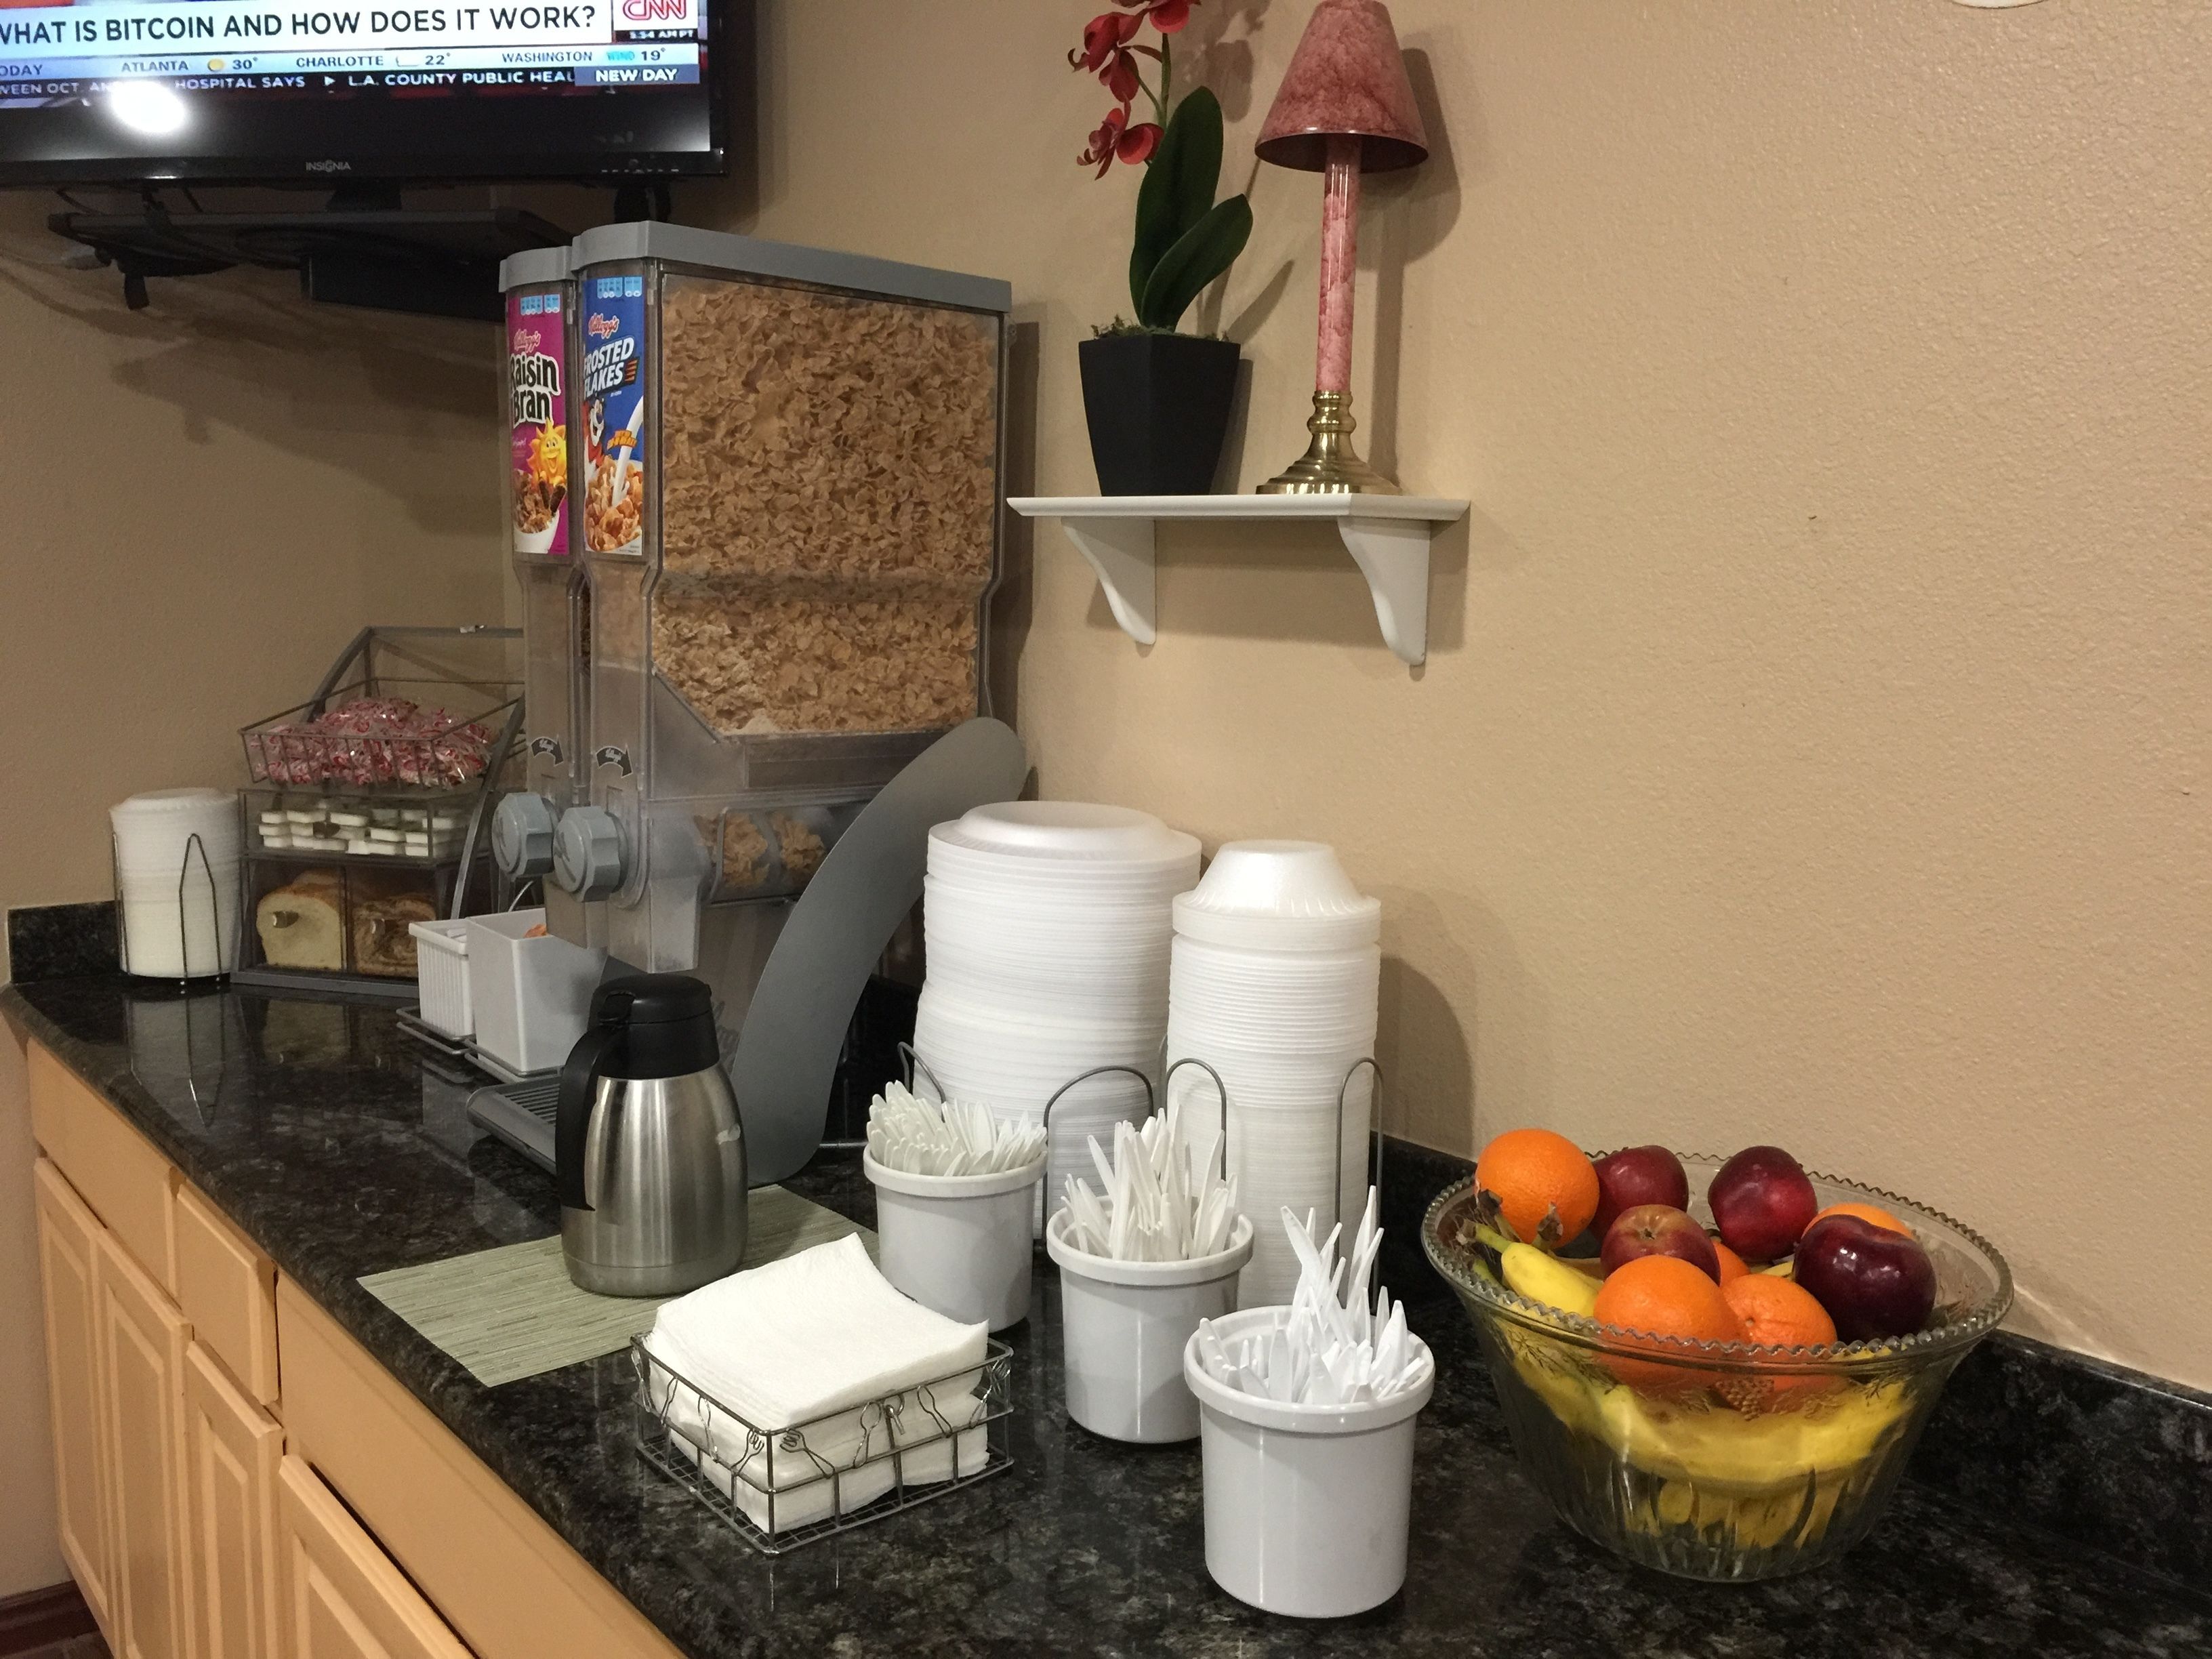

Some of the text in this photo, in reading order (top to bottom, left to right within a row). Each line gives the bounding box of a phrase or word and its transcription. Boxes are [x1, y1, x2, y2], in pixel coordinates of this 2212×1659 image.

[623, 0, 687, 20] CNN
[75, 20, 97, 42] IS
[106, 16, 213, 41] BITCOIN
[224, 14, 282, 37] AND
[291, 12, 361, 35] HOW
[371, 9, 446, 33] DOES
[456, 8, 480, 30] IT
[489, 5, 596, 30] WORK?
[296, 56, 384, 67] CHARLOTTE
[502, 51, 592, 62] WASHINGTON
[121, 60, 189, 73] ATLANTA
[596, 68, 677, 82] NEW DAY
[47, 82, 79, 94] OCT
[174, 77, 256, 89] HOSPITAL
[262, 75, 305, 88] SAYS
[384, 73, 457, 85] COUNTY
[462, 71, 525, 84] PUBLIC
[530, 70, 575, 83] HEAL
[305, 159, 351, 172] INSIGNIA
[510, 353, 560, 393] Raisin
[512, 389, 552, 427] Bran
